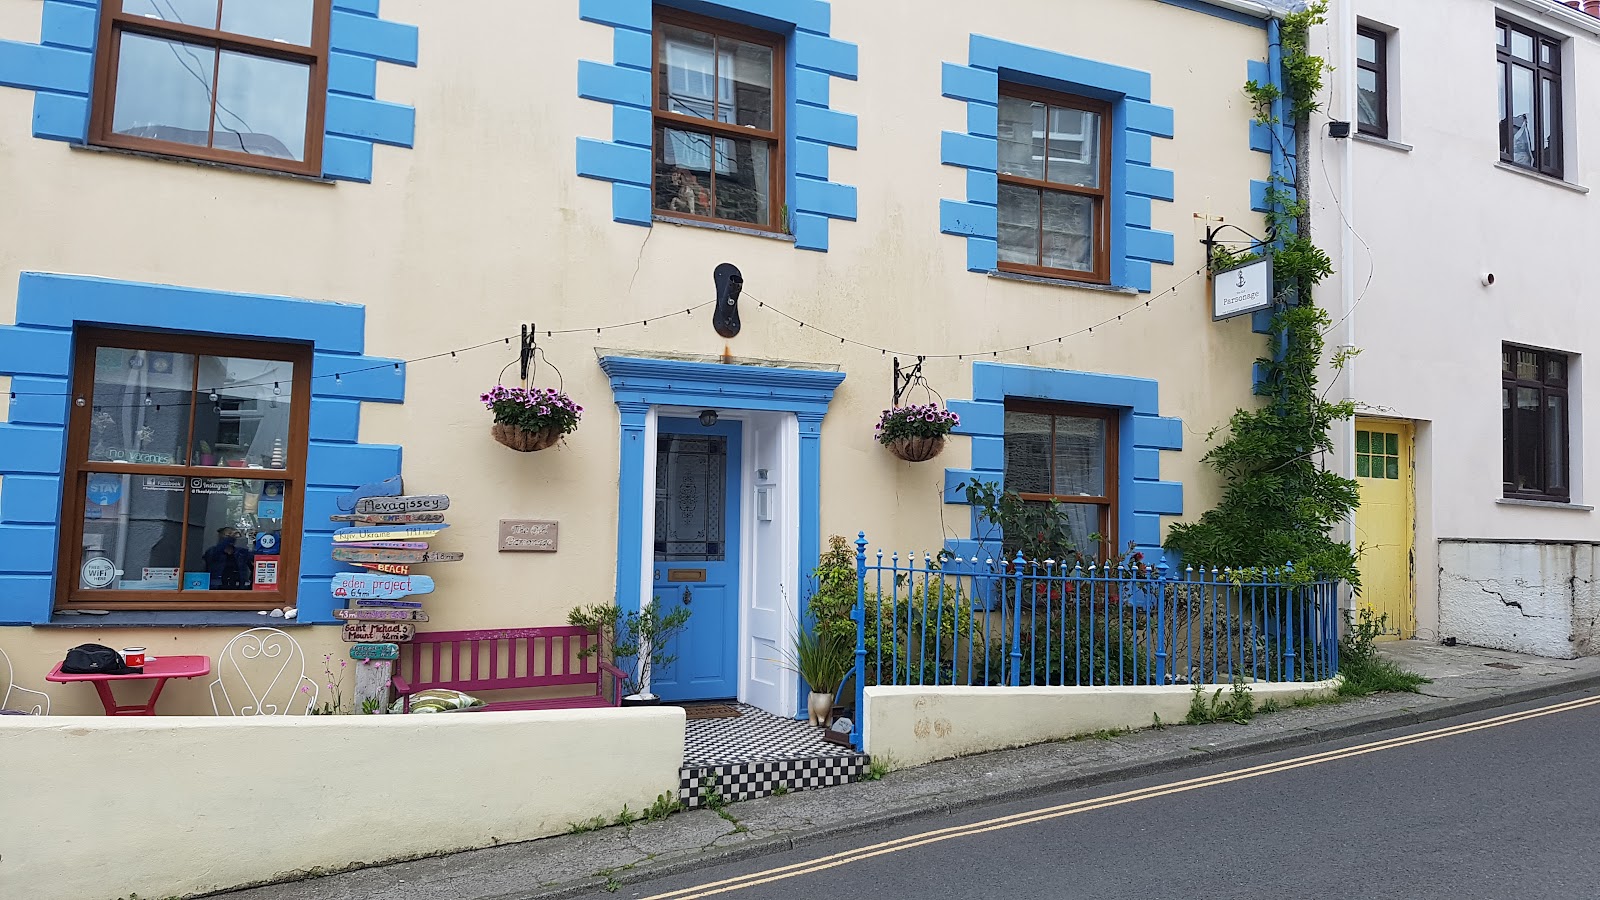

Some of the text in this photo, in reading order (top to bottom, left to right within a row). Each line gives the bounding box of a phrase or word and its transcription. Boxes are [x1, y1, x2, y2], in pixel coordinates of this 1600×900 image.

[1223, 291, 1260, 306] Parsonage
[90, 483, 119, 493] STAY
[364, 499, 440, 512] Mevagissey
[359, 529, 391, 539] Ukraine
[262, 537, 274, 545] 9.8
[377, 563, 409, 574] BEACH
[342, 575, 413, 594] eden project
[345, 623, 408, 633] Saint Michael's
[348, 632, 374, 640] Mount
